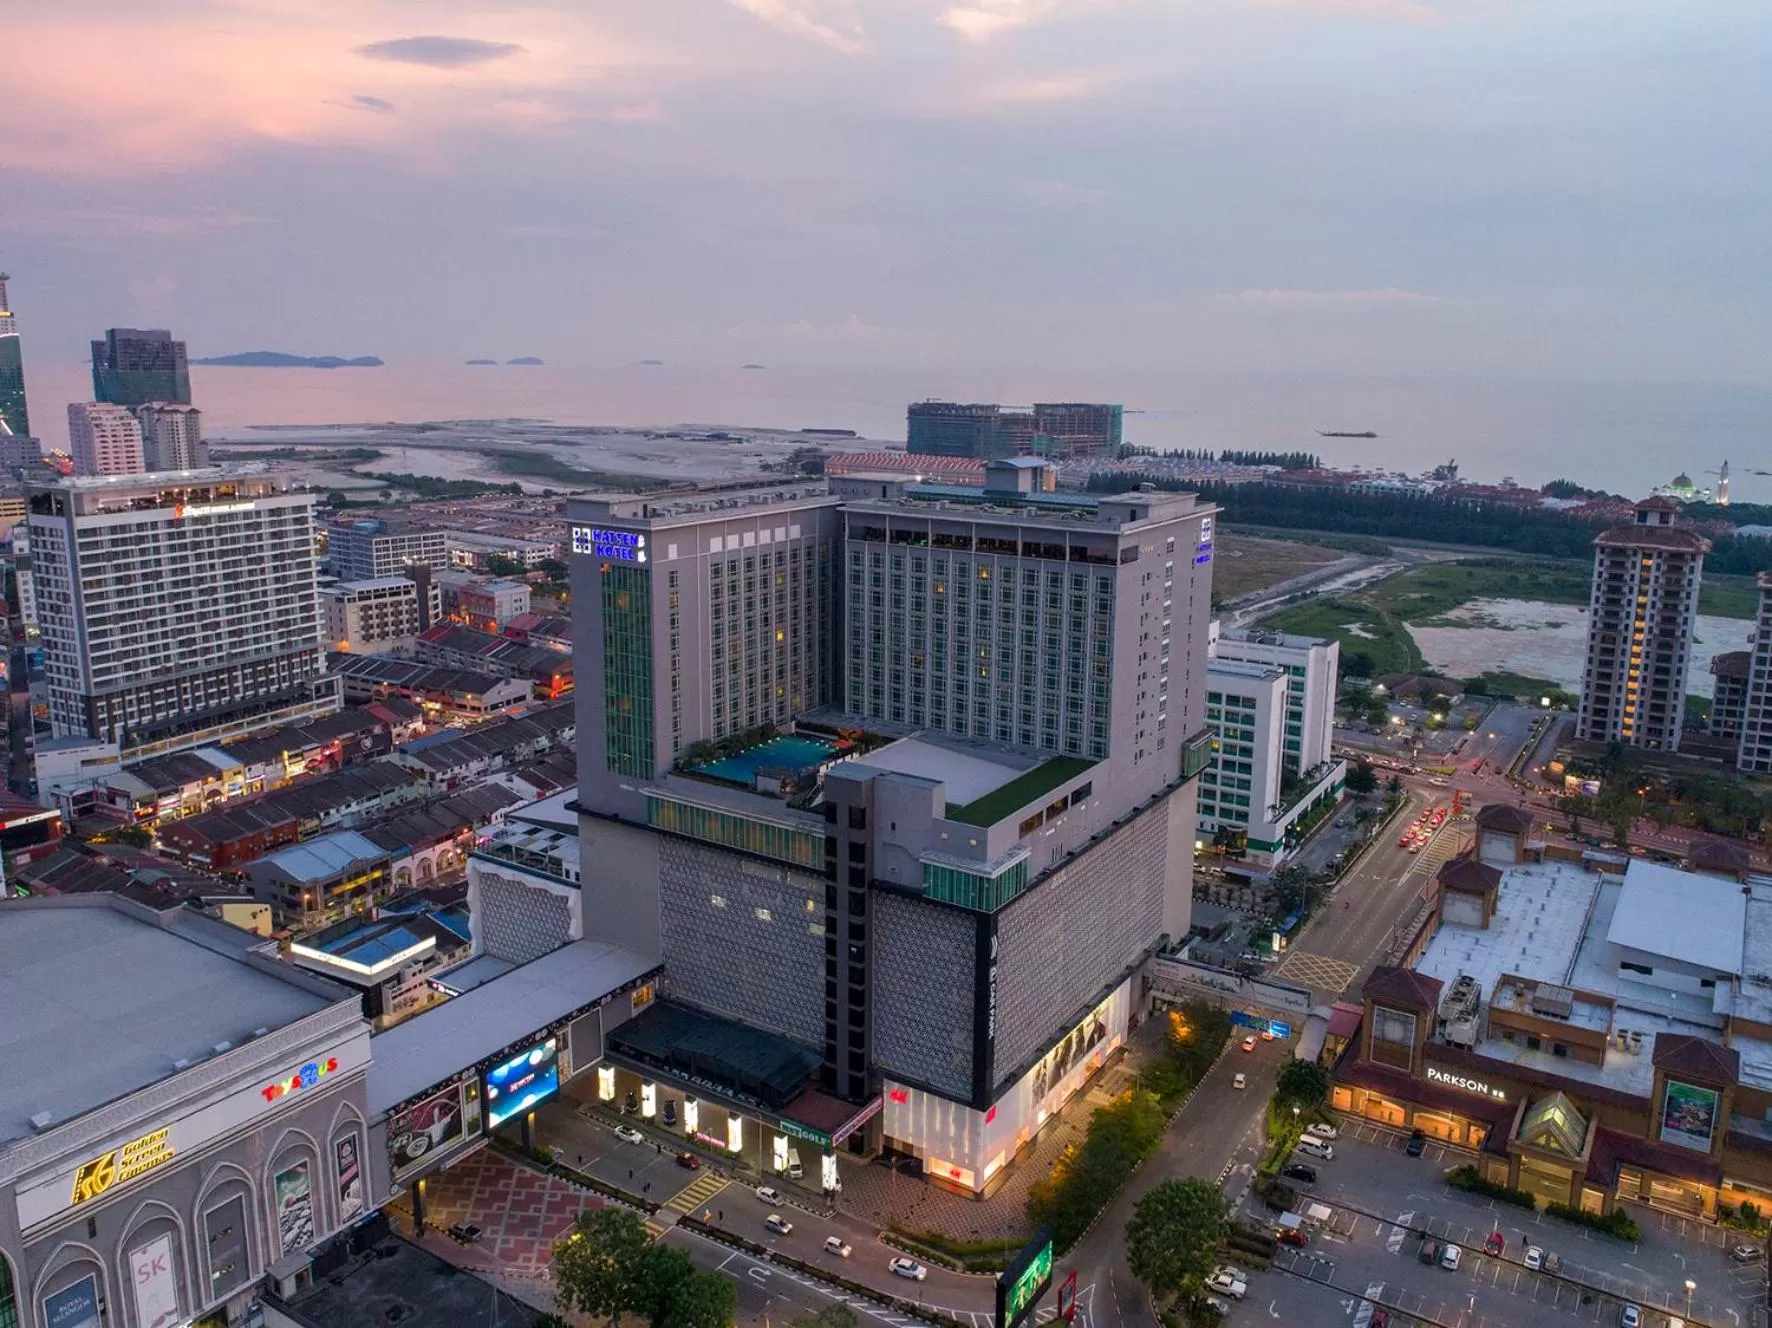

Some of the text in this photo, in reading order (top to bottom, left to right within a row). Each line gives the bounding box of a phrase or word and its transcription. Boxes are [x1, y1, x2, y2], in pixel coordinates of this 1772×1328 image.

[592, 529, 639, 546] HATTEN
[595, 544, 636, 560] HOTEL
[1427, 1067, 1488, 1093] PARKSON
[121, 1141, 165, 1168] Screen
[123, 1127, 169, 1156] Golden
[118, 1148, 175, 1182] Cinemas
